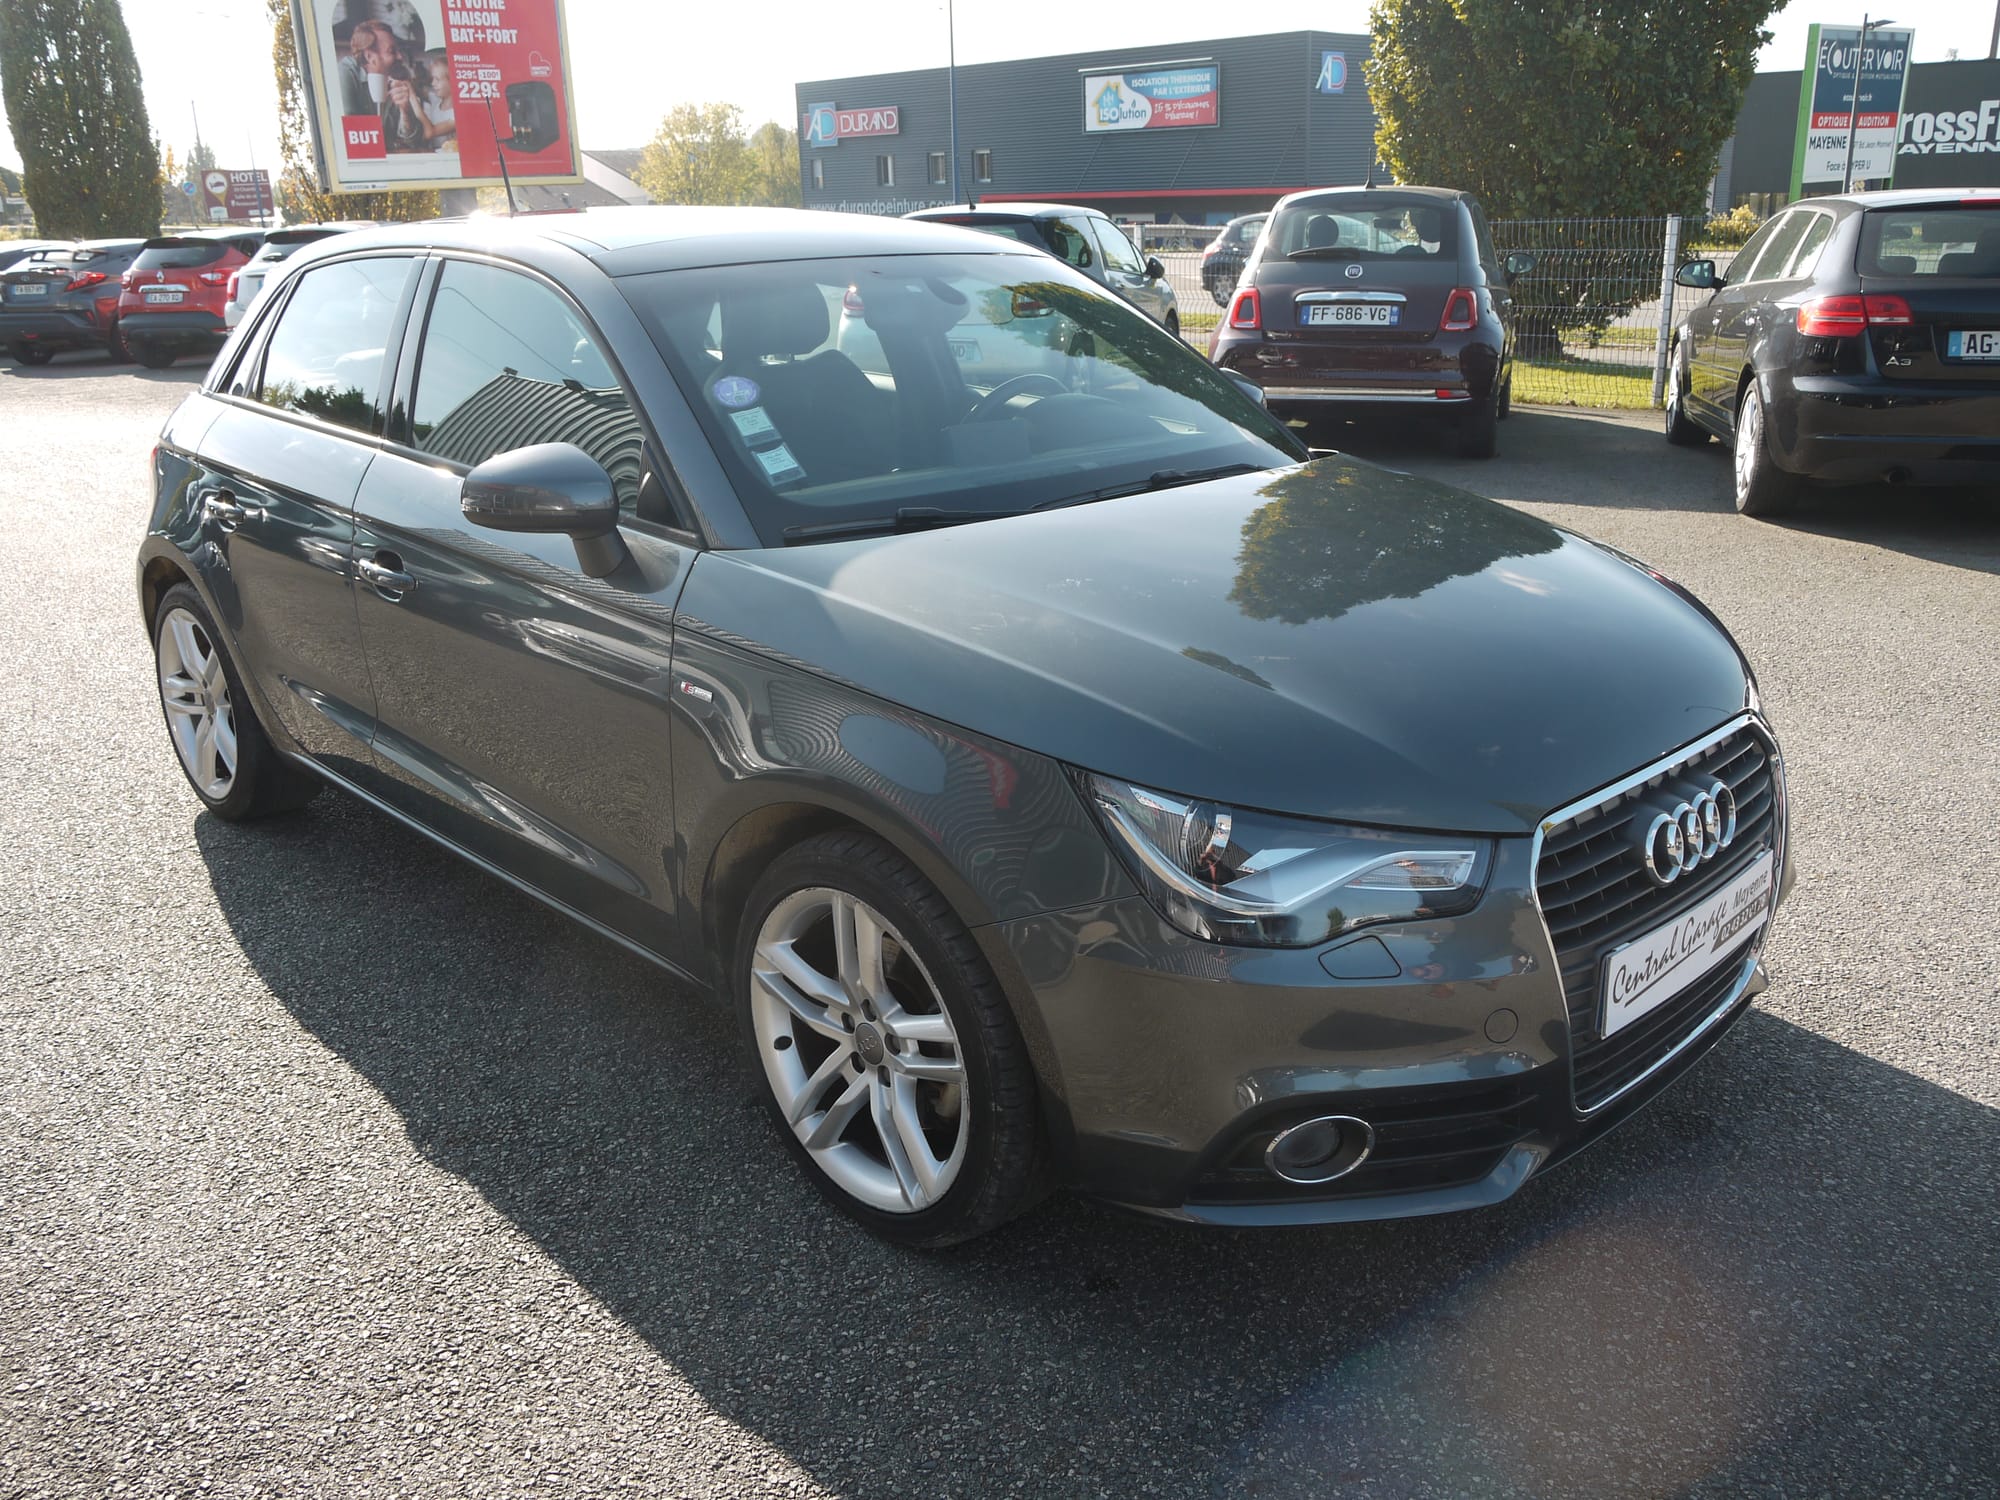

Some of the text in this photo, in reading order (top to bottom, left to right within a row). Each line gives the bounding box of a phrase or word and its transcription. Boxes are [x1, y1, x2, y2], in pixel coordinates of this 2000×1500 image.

[448, 11, 500, 26] MAISON
[453, 54, 480, 62] PHILIPS
[1876, 48, 1904, 71] VOIR
[1315, 55, 1348, 89] AD
[1132, 77, 1169, 88] ISOLATION
[1153, 86, 1168, 96] PAR
[805, 107, 898, 141] AD DURAND
[1818, 115, 1890, 127] OPTIQUE AUDITION
[348, 130, 379, 145] BUT
[1808, 135, 1848, 150] MAYENNE
[1897, 141, 2000, 154] AYENN
[230, 171, 268, 183] HOTEL
[1311, 306, 1387, 321] FF-686-VG
[1885, 355, 1912, 366] A3
[1612, 869, 1769, 1004] Central Garage Mayenne
